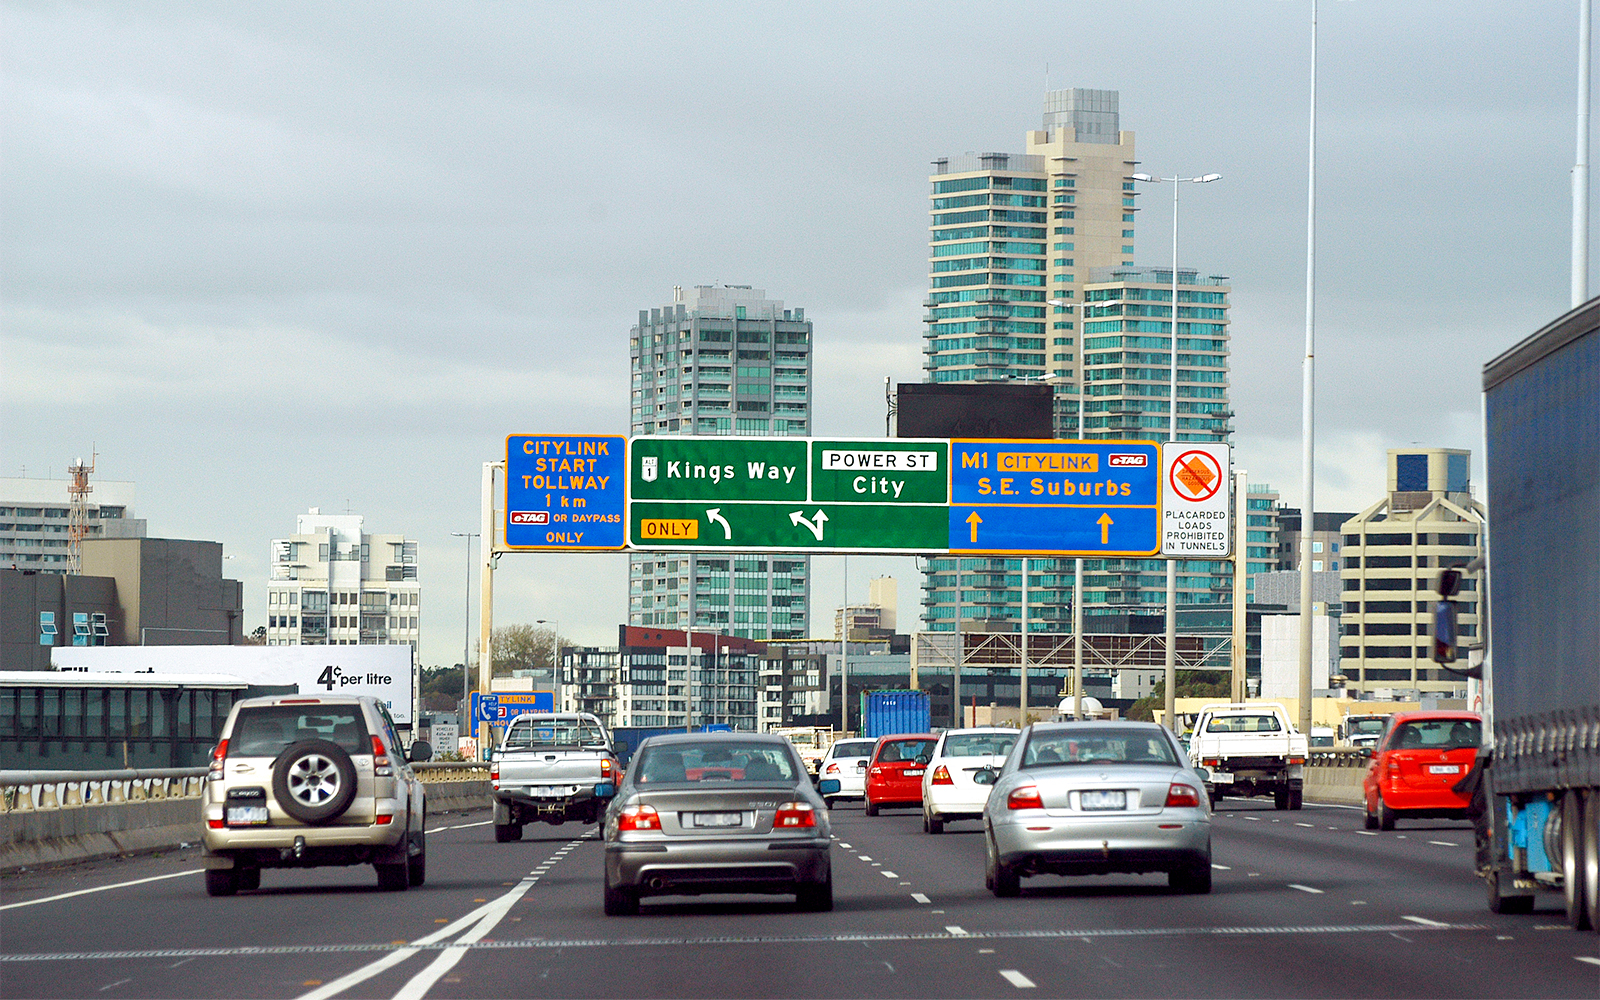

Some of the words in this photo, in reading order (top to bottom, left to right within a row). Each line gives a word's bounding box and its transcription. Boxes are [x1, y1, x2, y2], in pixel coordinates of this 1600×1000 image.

[523, 440, 609, 455] CITYLINK
[536, 458, 597, 472] START
[830, 454, 896, 467] POWER
[906, 455, 929, 468] ST
[962, 452, 988, 469] M1
[1003, 456, 1092, 469] CITYLINK
[647, 467, 651, 477] 1
[667, 461, 735, 484] Kings
[748, 462, 796, 483] Way
[522, 475, 610, 490] TOLLWAY
[853, 476, 905, 498] City
[978, 478, 1019, 495] S.E.
[1030, 478, 1131, 496] Suburbs
[545, 494, 550, 507] 1
[561, 494, 586, 507] km
[553, 514, 567, 522] OR
[572, 514, 621, 523] DAYPASS
[1166, 511, 1225, 519] PLACARDED
[647, 523, 692, 535] ONLY
[1167, 532, 1224, 540] PROHIBITED
[546, 532, 583, 543] ONLY
[1180, 542, 1225, 550] TUNNELS
[341, 676, 363, 687] per
[367, 673, 392, 684] litre
